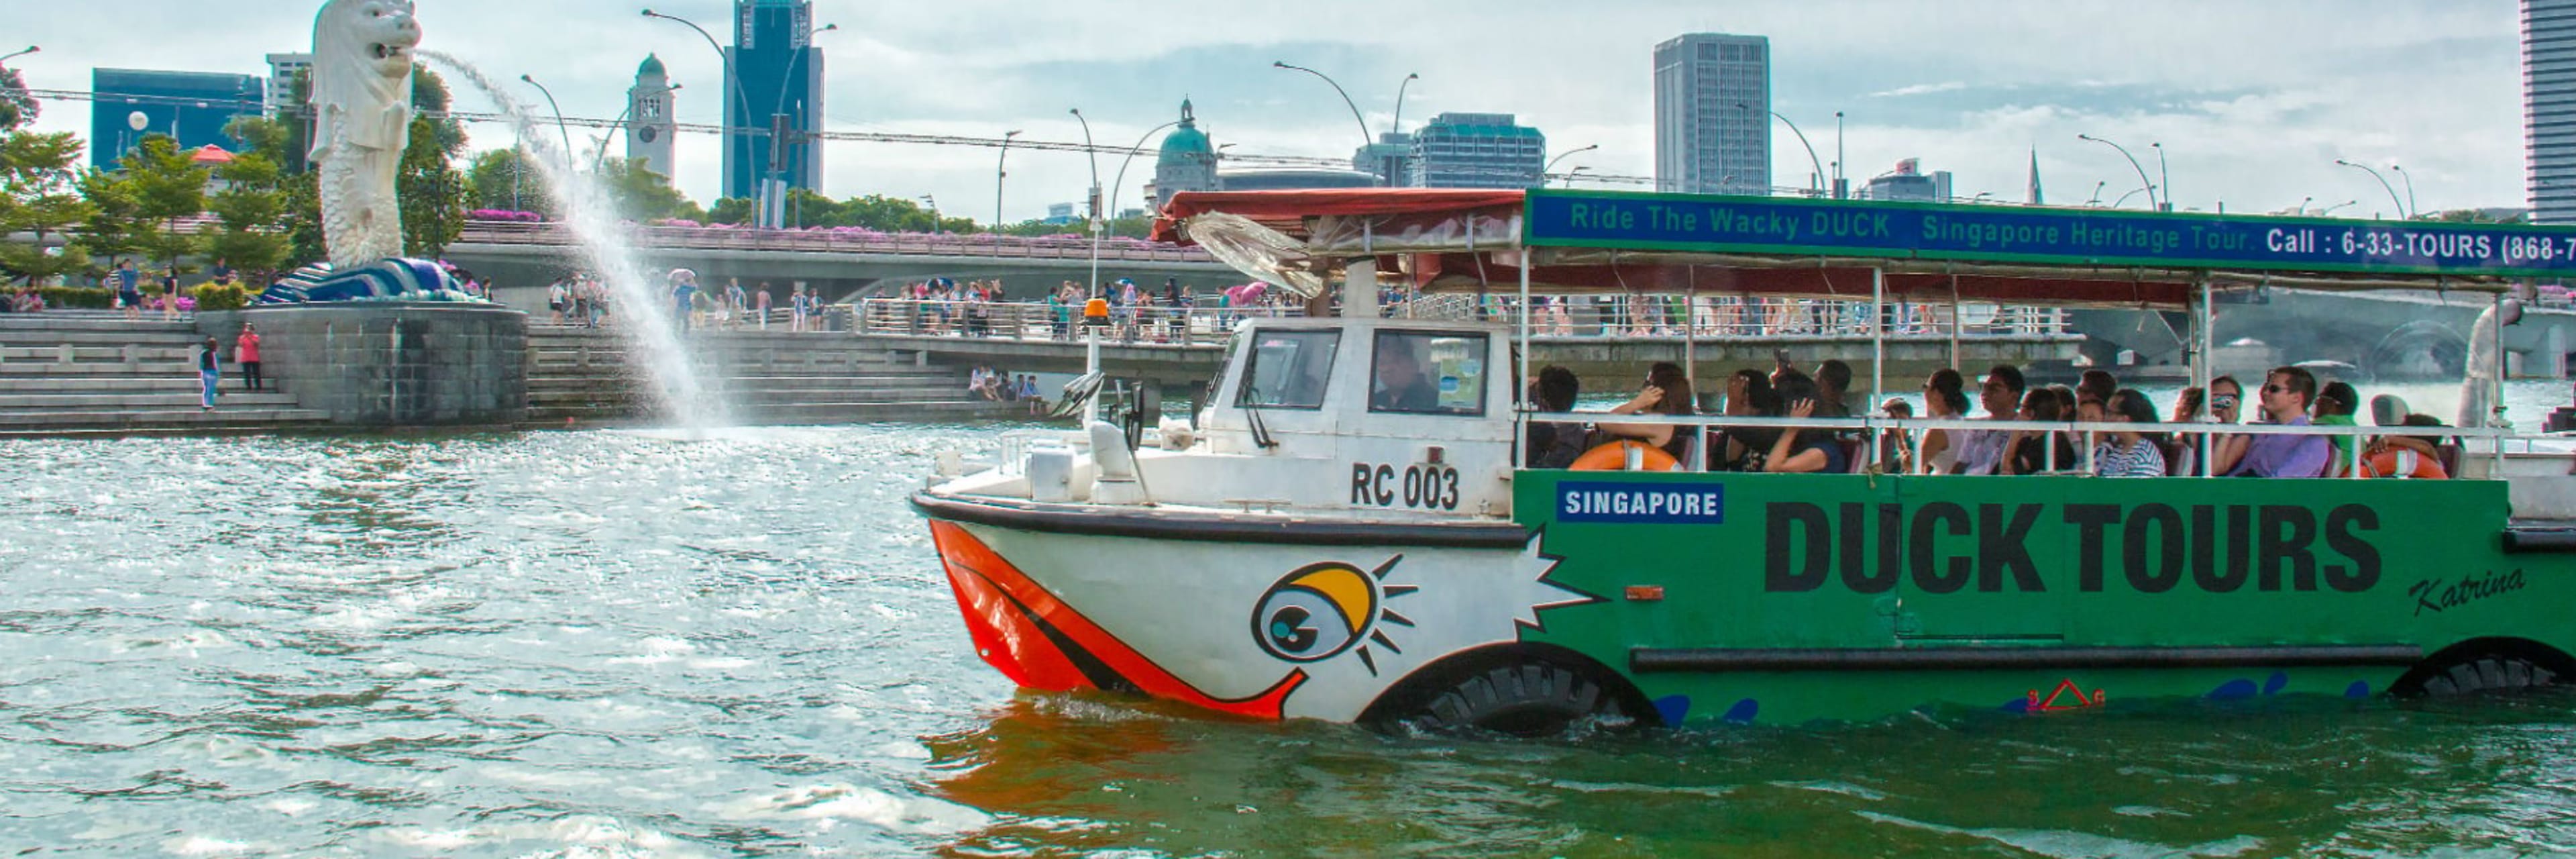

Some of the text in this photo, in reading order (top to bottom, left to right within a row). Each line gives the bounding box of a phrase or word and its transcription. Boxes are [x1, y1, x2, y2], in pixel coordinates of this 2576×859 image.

[1570, 203, 1634, 230] Ride
[1647, 205, 1697, 231] The
[1710, 207, 1799, 240] Wacky
[1812, 211, 1889, 238] DUCK
[1923, 215, 2059, 248] Singapore
[2071, 221, 2180, 253] Heritage
[2267, 228, 2314, 253] Call
[2342, 232, 2491, 258] 6-33-TOURS
[2501, 236, 2576, 265] (868-7
[1351, 463, 1459, 510] RC 003
[1565, 491, 1717, 515] SINGAPORE
[1765, 501, 2382, 594] DUCK TOURS
[2408, 568, 2526, 617] Katrina
